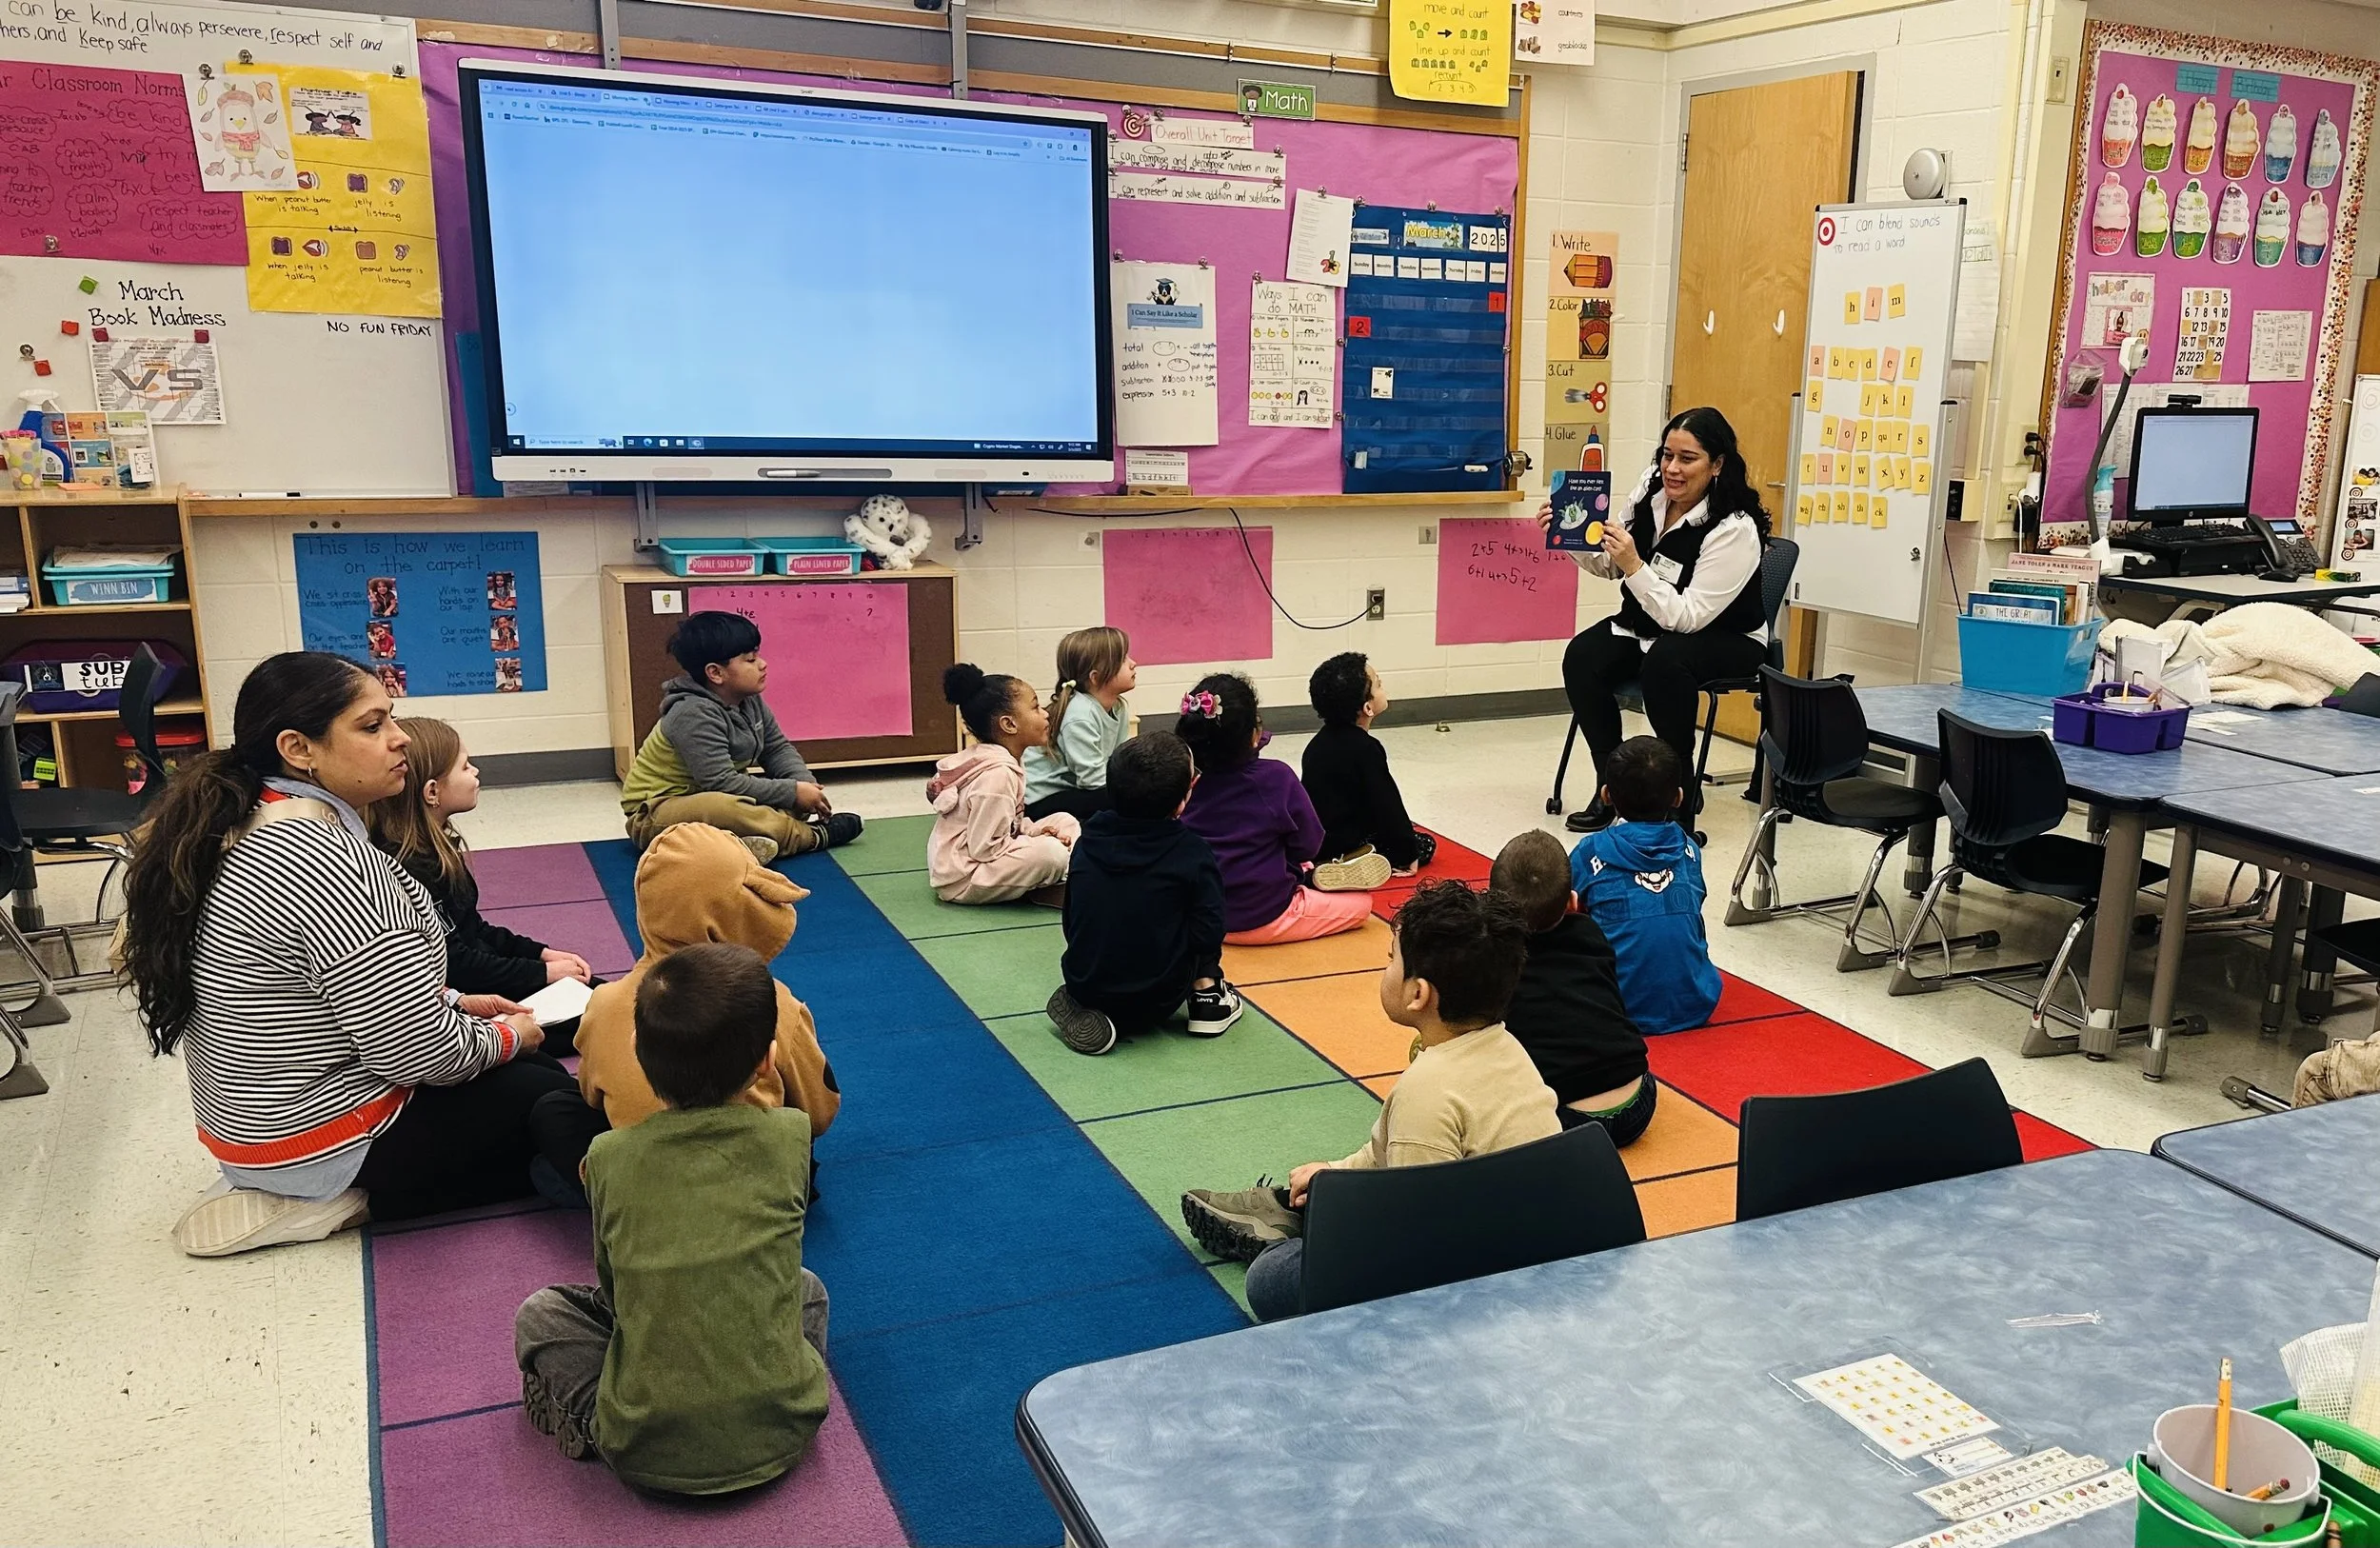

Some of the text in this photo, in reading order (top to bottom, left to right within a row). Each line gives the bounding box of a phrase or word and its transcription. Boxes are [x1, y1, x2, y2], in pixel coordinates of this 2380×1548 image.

[1424, 3, 1489, 19] move and count
[9, 2, 44, 16] can
[54, 4, 80, 24] be
[137, 11, 193, 38] always
[270, 28, 321, 47] respect
[329, 31, 354, 50] self
[361, 38, 383, 50] and
[119, 36, 149, 53] safe
[1416, 43, 1491, 58] line up and count
[31, 68, 186, 98] Classroom Norms
[1265, 90, 1308, 111] Math
[116, 108, 183, 127] be kind
[1155, 125, 1251, 148] Overall Unit Target
[157, 150, 178, 166] try
[1110, 145, 1116, 160] I
[1121, 152, 1136, 163] can
[1140, 154, 1168, 167] compose
[1173, 154, 1187, 166] and
[1228, 159, 1252, 171] numbers
[163, 170, 196, 184] best
[1110, 178, 1281, 204] I can represent and solve addition and subtraction
[254, 194, 277, 203] When
[284, 196, 309, 206] peanut
[352, 197, 372, 208] jelly
[149, 205, 232, 221] respect teacher
[289, 204, 320, 215] talking
[367, 210, 402, 222] listening
[1839, 213, 1941, 234] I can blend sounds
[1406, 225, 1506, 247] March 2025
[1560, 234, 1591, 252] Write
[1834, 244, 1843, 253] to
[1848, 239, 1870, 252] read
[1886, 236, 1905, 248] word
[292, 261, 313, 271] jelly
[359, 266, 383, 275] peanut
[285, 272, 316, 283] talking
[378, 275, 412, 288] listening
[118, 279, 185, 302] March
[1256, 286, 1327, 303] Ways I can
[2092, 280, 2150, 304] helper day
[1268, 303, 1317, 314] do MATH
[1494, 297, 1499, 308] 1
[1549, 299, 1578, 311] 2. Color
[1850, 302, 1855, 312] h
[1892, 296, 1901, 306] m
[89, 306, 227, 327] Book Madness
[2185, 308, 2229, 318] 6 7 8 9 10
[327, 321, 431, 336] NO FUN FRIDAY
[1357, 321, 1364, 333] 2
[1122, 343, 1144, 352] total
[1121, 362, 1149, 370] addition
[1834, 356, 1839, 367] b
[1849, 360, 1854, 368] c
[1866, 358, 1872, 368] d
[1548, 364, 1575, 377] 3. Cut
[110, 368, 203, 390] VS
[1555, 427, 1577, 440] Glue
[296, 534, 525, 555] This is how we learn
[345, 554, 482, 576] on the carpet!
[692, 556, 752, 568] DOUBLE SIDED PAPER
[793, 556, 849, 568] PLAIN LINED PAPER
[90, 582, 138, 596] WINN BIN
[1995, 608, 2008, 617] THE
[79, 662, 125, 677] SUB
[80, 676, 124, 688] tub
